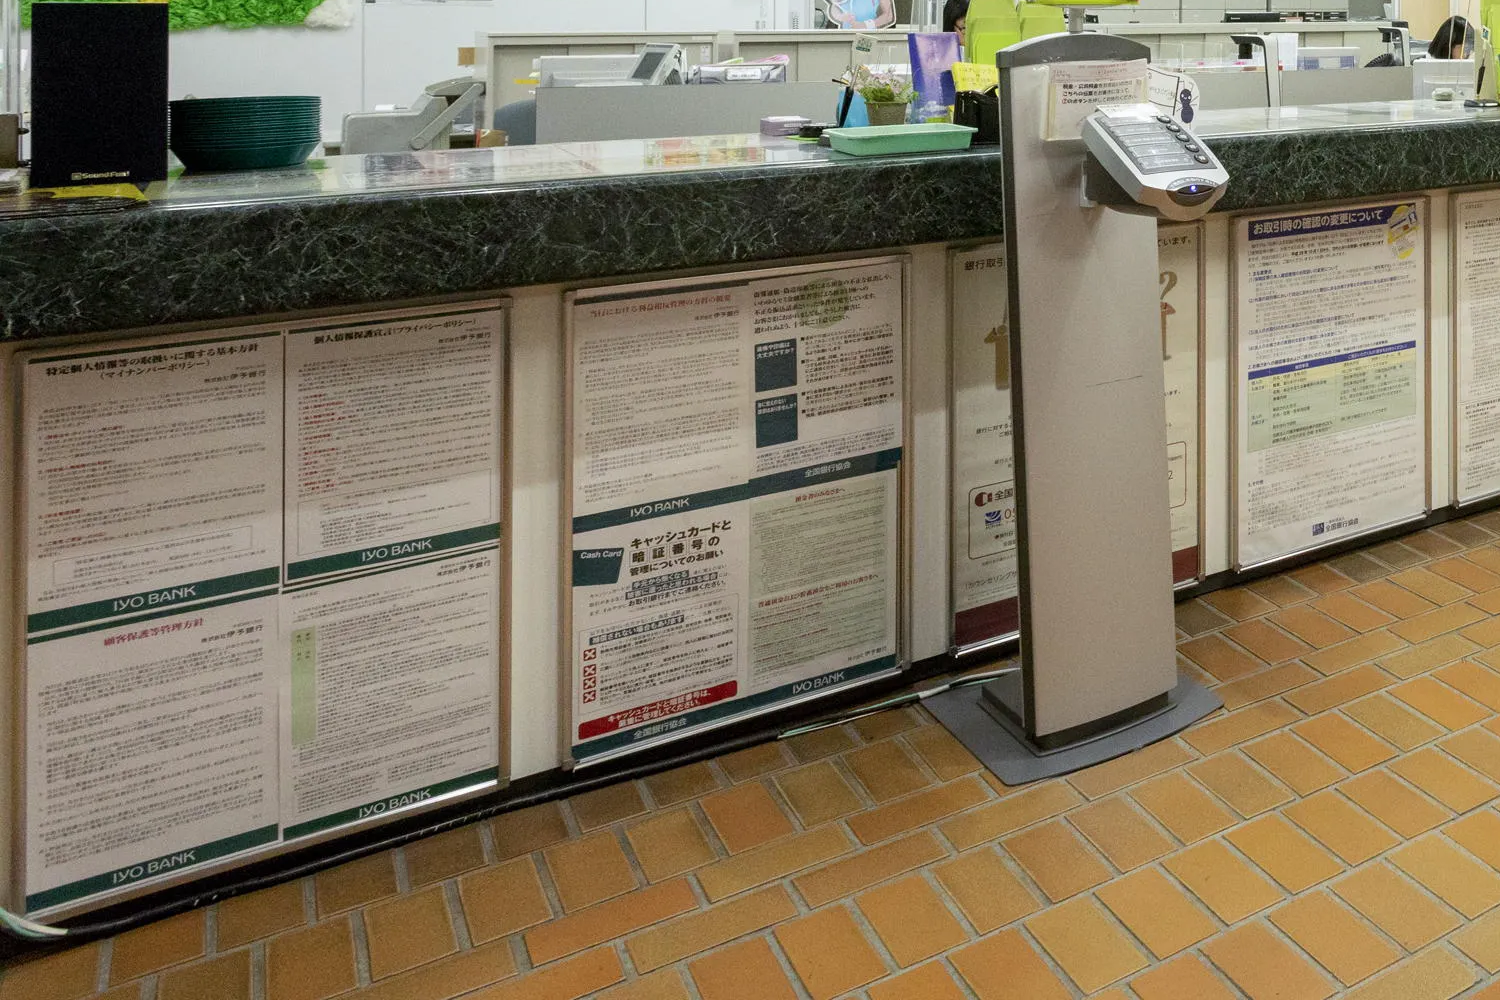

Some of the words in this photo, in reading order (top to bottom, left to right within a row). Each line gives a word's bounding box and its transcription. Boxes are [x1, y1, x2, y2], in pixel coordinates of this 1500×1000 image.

[1253, 209, 1384, 235] お取引時の確認の変更について
[46, 343, 259, 377] 特定個人情報等の取扱いに関する基本方針
[630, 503, 652, 517] IYO
[653, 497, 690, 513] BANK
[630, 519, 732, 549] キャッシュカードと
[361, 546, 389, 563] IYO
[391, 538, 433, 556] BANK
[580, 550, 601, 559] Cash
[602, 549, 623, 559] Card
[629, 548, 724, 577] 管理についてのお願い
[631, 535, 720, 563] 暗証番号の
[113, 595, 145, 612] IYO
[148, 584, 197, 605] BANK
[103, 617, 204, 647] 顧客保護等管理方針
[792, 680, 812, 694] IYO
[813, 671, 845, 688] BANK
[607, 689, 712, 722] キャッシュカードと暗証番号は、
[633, 717, 688, 739] 全国銀行協会
[358, 801, 386, 818] IYO
[388, 788, 432, 809] BANK
[112, 864, 144, 885] IYO
[147, 849, 196, 873] BANK
